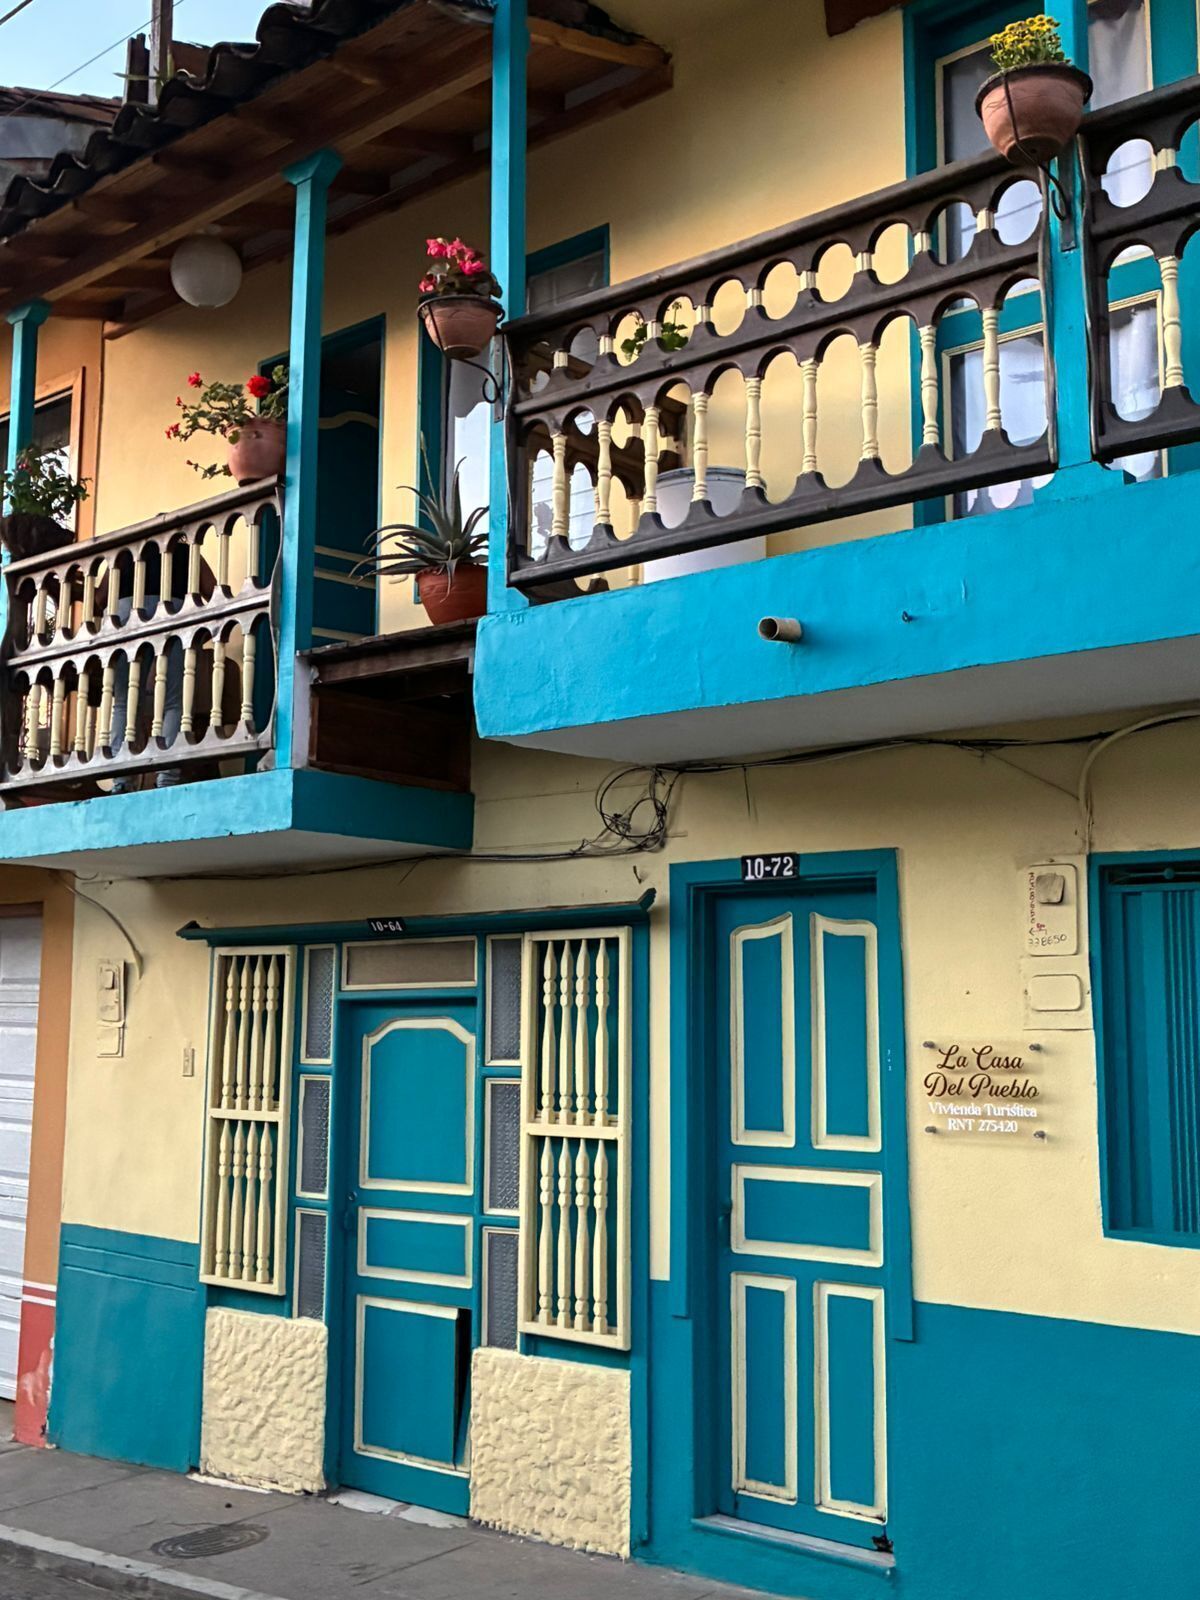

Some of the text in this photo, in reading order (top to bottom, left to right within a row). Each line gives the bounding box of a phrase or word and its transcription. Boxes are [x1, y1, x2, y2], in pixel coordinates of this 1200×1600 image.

[744, 855, 794, 880] 10-72
[370, 920, 403, 932] 10-64
[936, 1044, 1024, 1071] La Casa
[923, 1071, 1040, 1099] Del Pueblo
[928, 1101, 982, 1116] Vivienda
[947, 1118, 1019, 1133] RNT 275420
